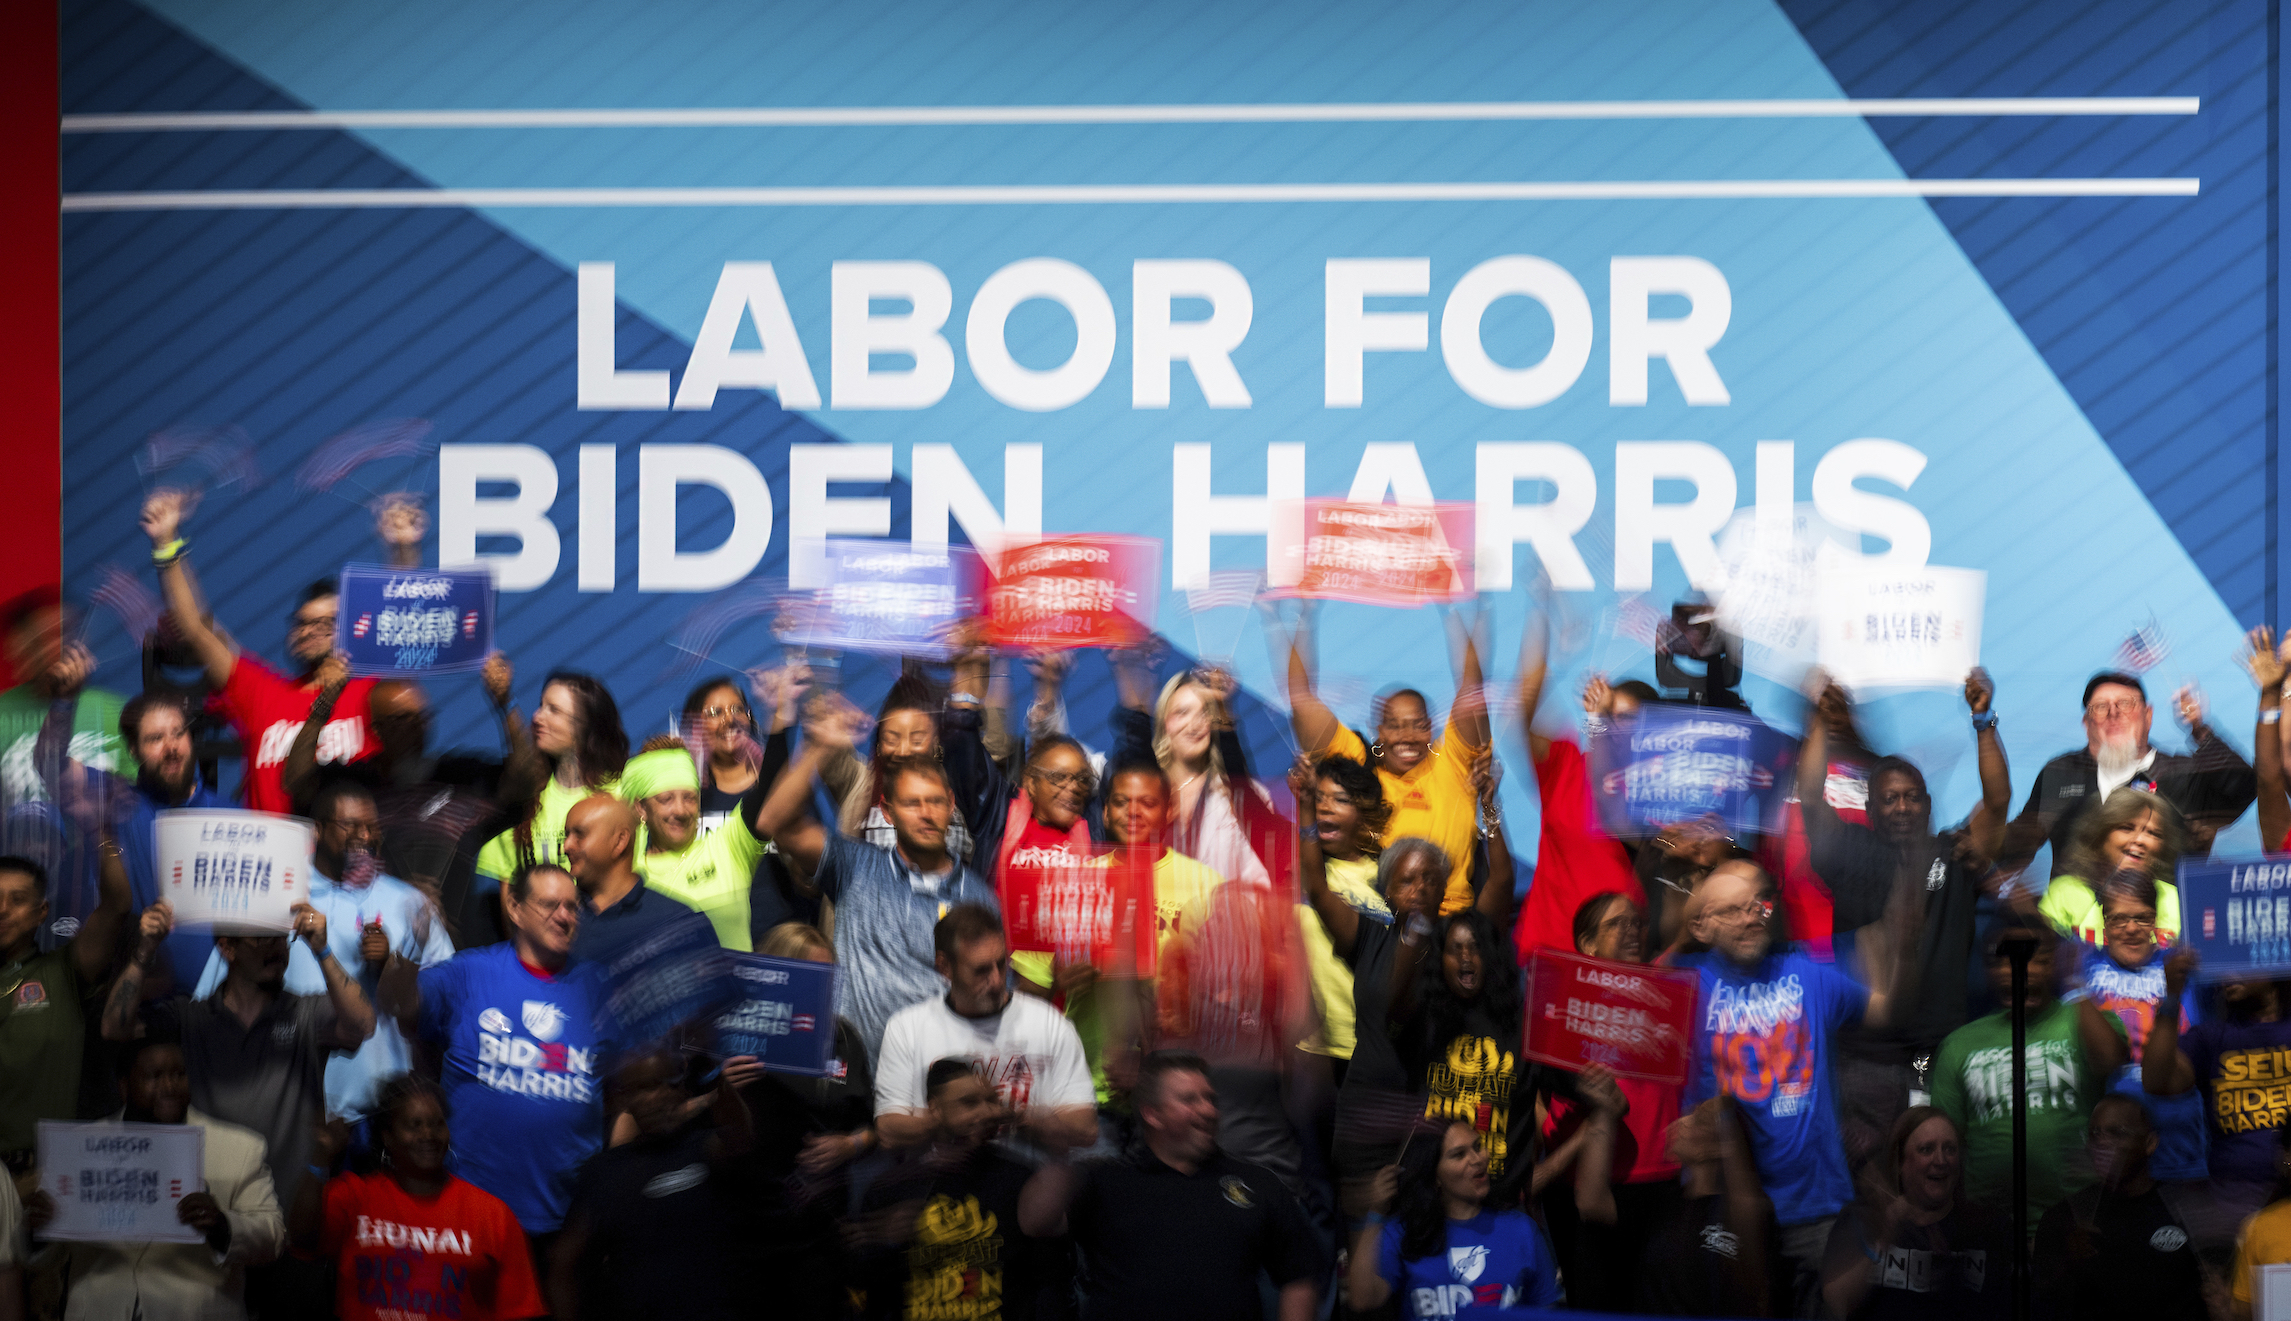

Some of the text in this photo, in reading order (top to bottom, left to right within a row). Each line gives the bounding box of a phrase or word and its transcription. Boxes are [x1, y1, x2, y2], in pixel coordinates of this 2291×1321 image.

[577, 255, 1732, 411] LABOR FOR
[439, 443, 1043, 592] BIDEN
[1172, 437, 1932, 591] HARRIS
[1048, 547, 1110, 564] LABOR
[1039, 577, 1116, 597] BIDEN
[1036, 595, 1114, 613] HARRIS
[1056, 616, 1093, 635] 2024
[1576, 966, 1643, 990] LABOR
[1567, 997, 1645, 1026] BIDEN
[478, 1031, 597, 1075] BIDEN
[477, 1063, 592, 1104] HARRIS
